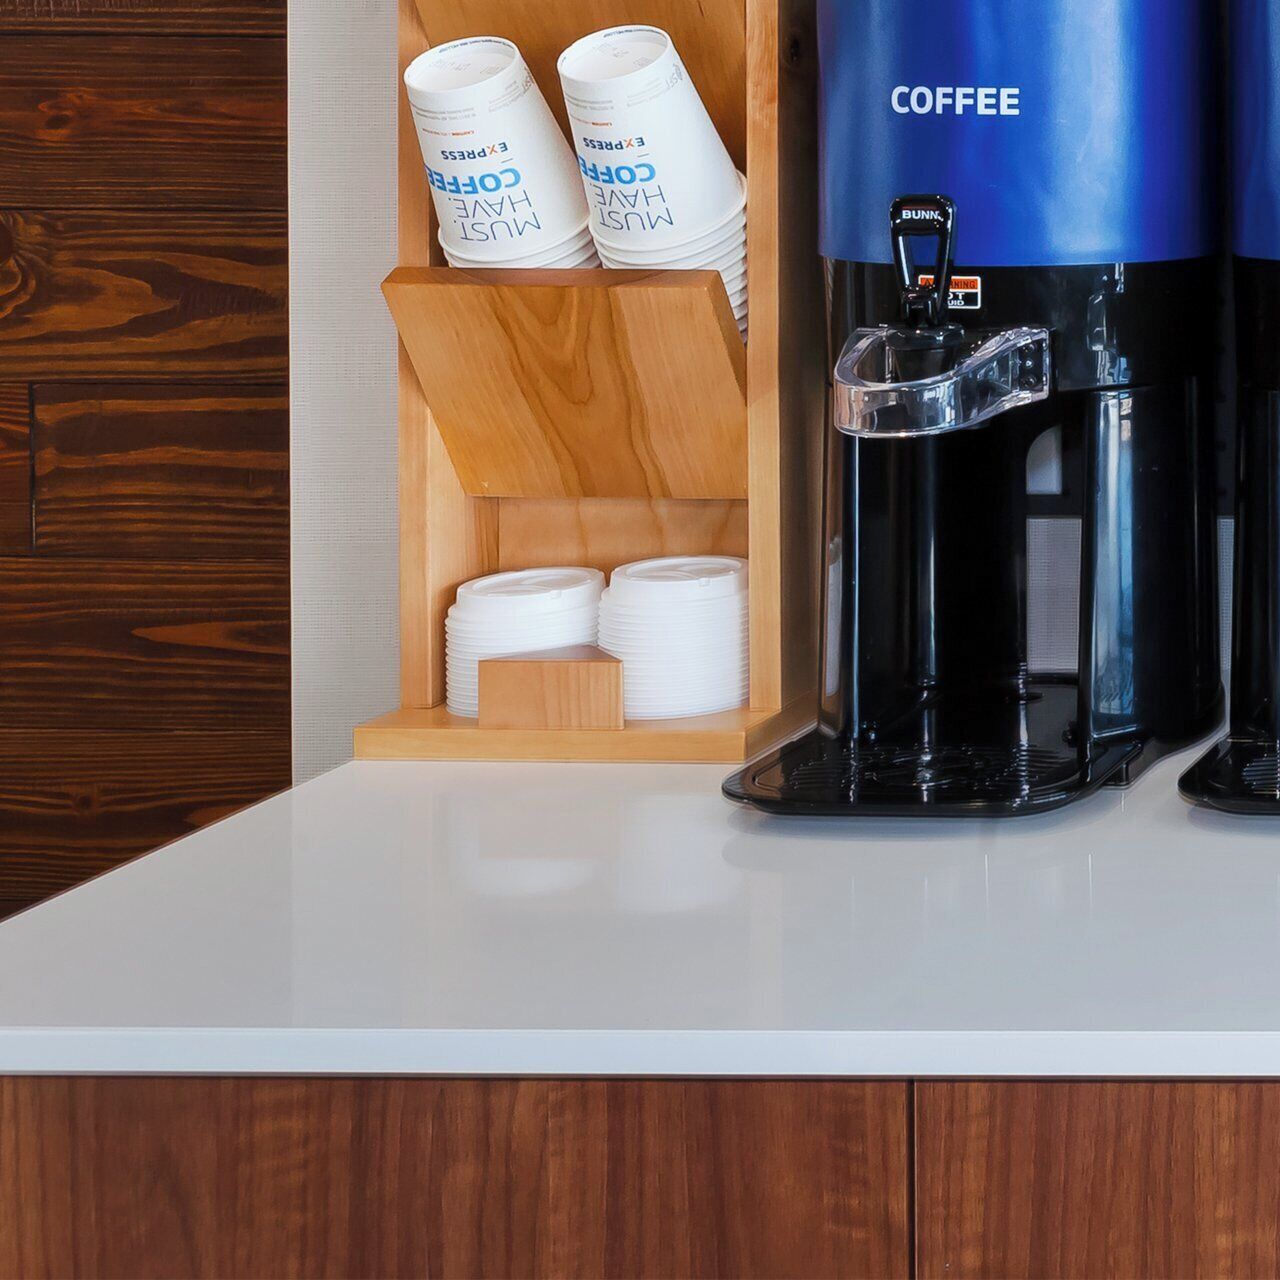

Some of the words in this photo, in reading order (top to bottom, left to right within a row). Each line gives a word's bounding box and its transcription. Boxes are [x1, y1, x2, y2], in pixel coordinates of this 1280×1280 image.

[890, 85, 1020, 115] COFFEE
[441, 141, 508, 160] EXPRESS
[582, 136, 645, 151] EXPRESS
[448, 189, 532, 218] HAVE.
[589, 182, 666, 209] HAVE.
[453, 212, 541, 241] MUST.
[594, 205, 674, 231] MUST.
[902, 210, 940, 220] BUNN
